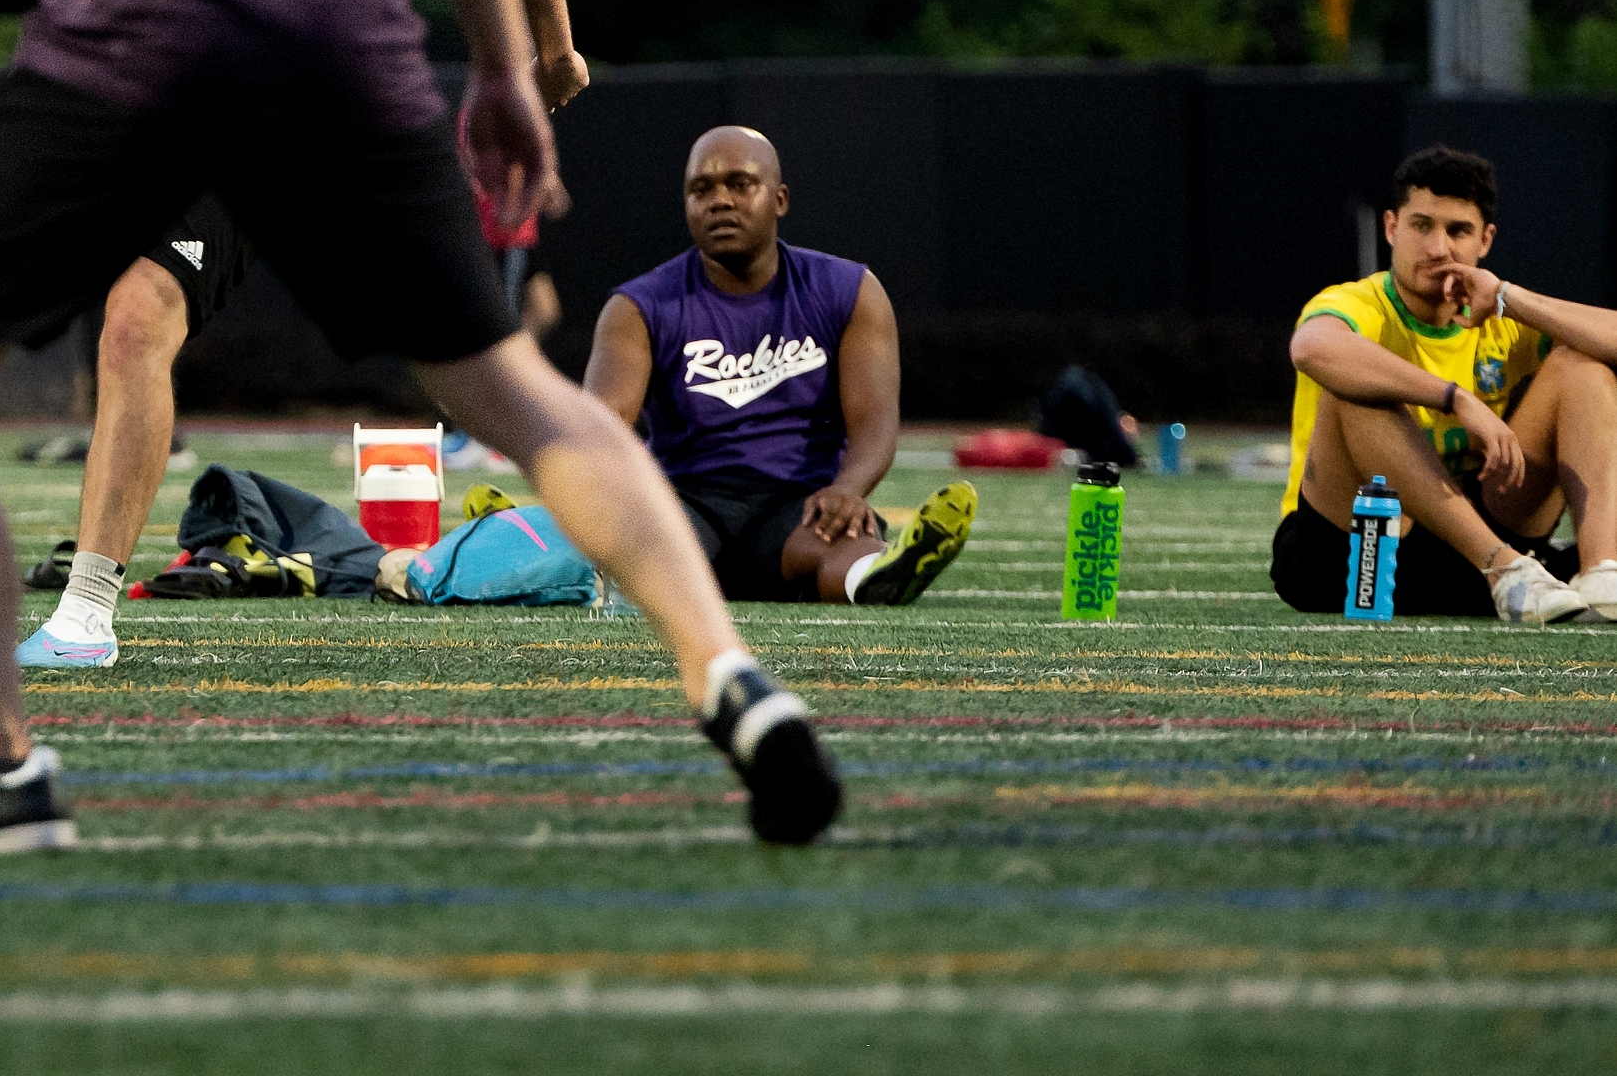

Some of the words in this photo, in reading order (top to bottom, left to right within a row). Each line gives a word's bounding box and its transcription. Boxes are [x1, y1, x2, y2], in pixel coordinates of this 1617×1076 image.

[682, 333, 824, 384] Rockies
[1071, 509, 1103, 612] pickle
[1096, 500, 1122, 602] pickle
[1358, 518, 1379, 608] POWERADE
